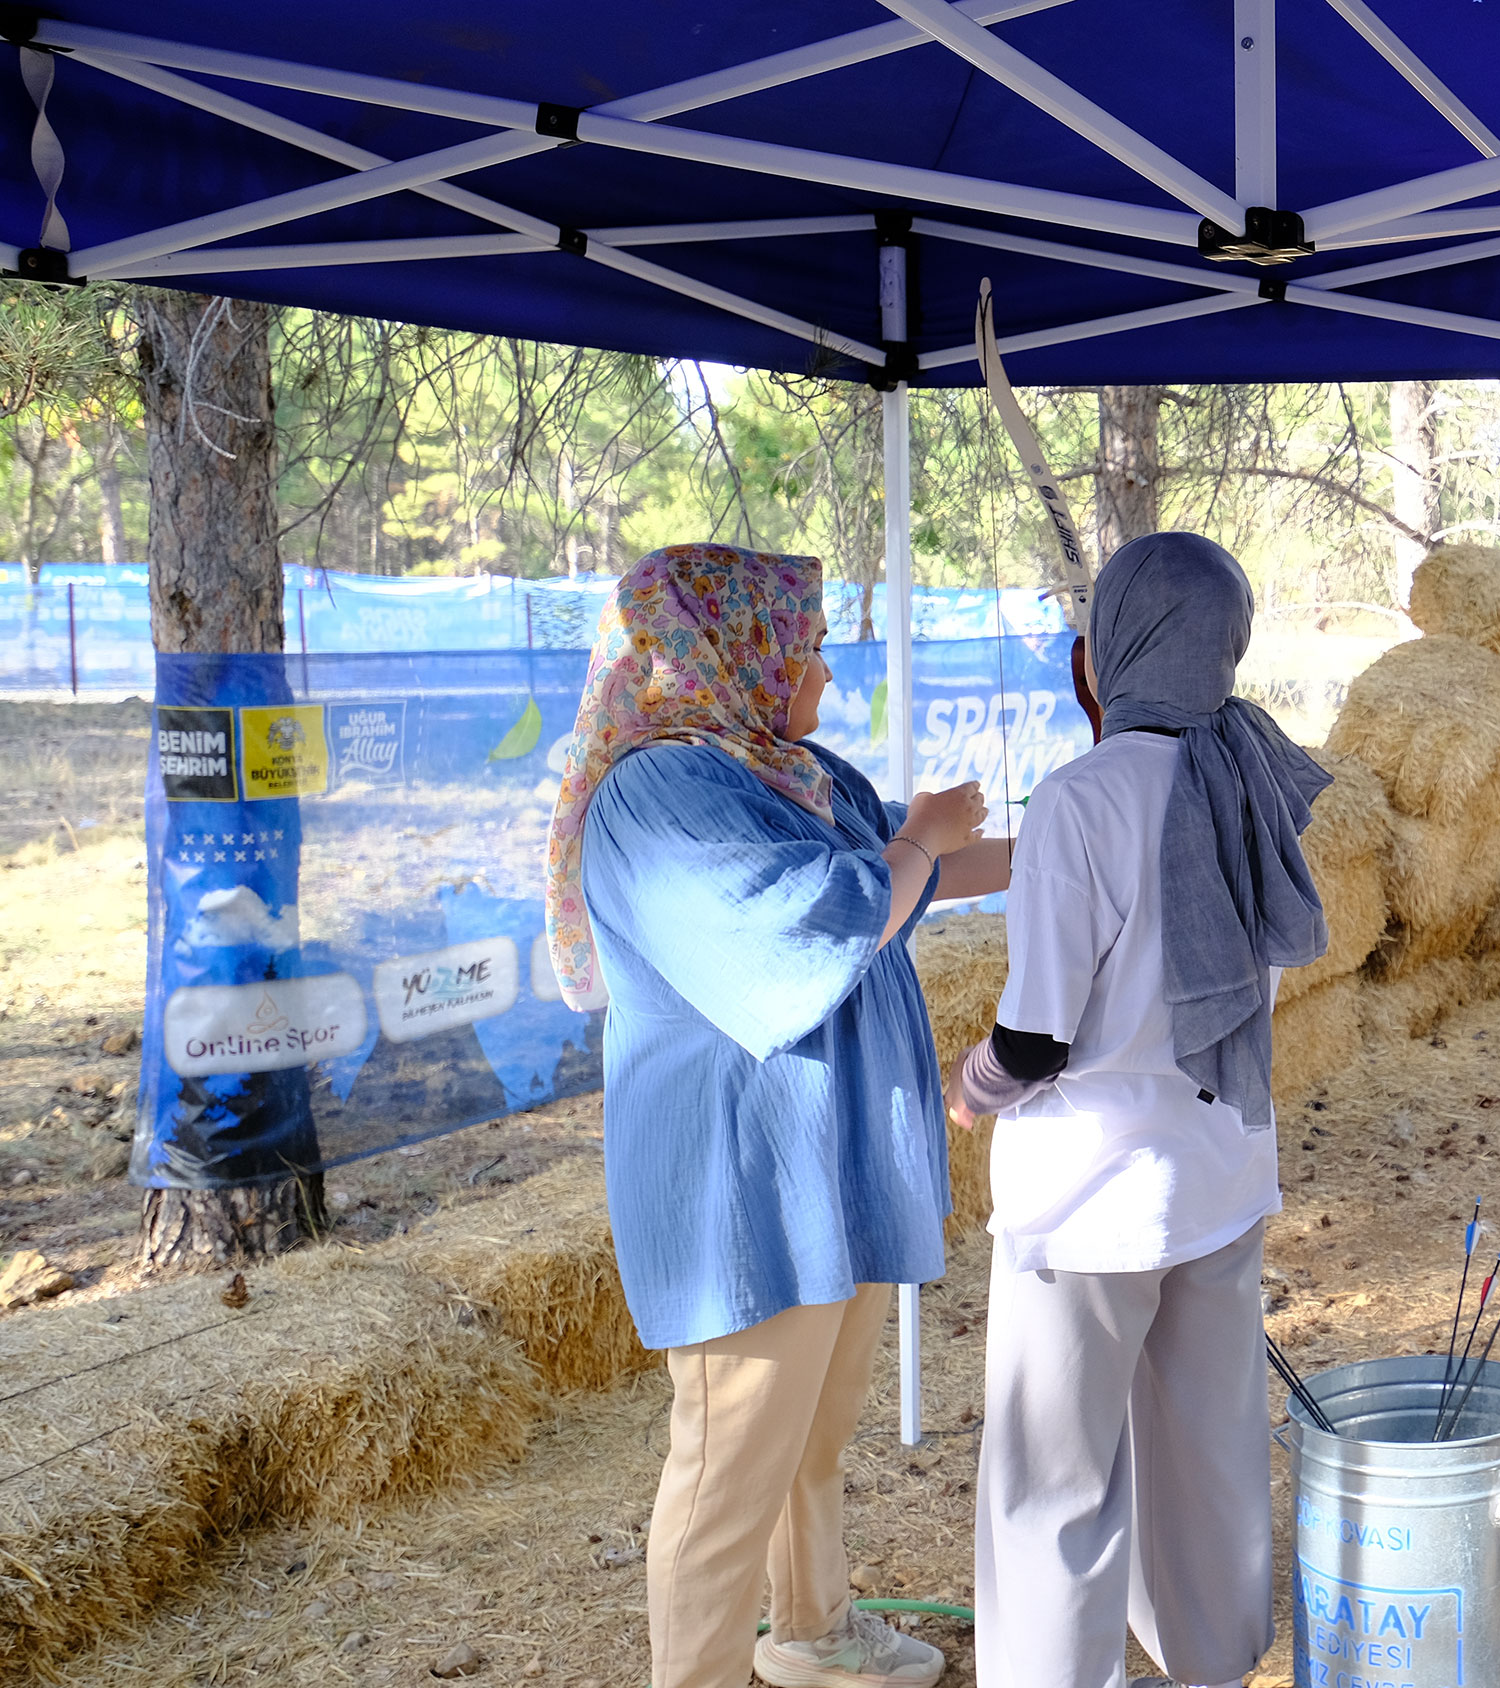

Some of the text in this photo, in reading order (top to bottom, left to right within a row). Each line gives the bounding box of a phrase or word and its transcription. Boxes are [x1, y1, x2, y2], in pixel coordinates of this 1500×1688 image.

[917, 689, 1057, 757] SPOR
[186, 1024, 341, 1058] Online Spor
